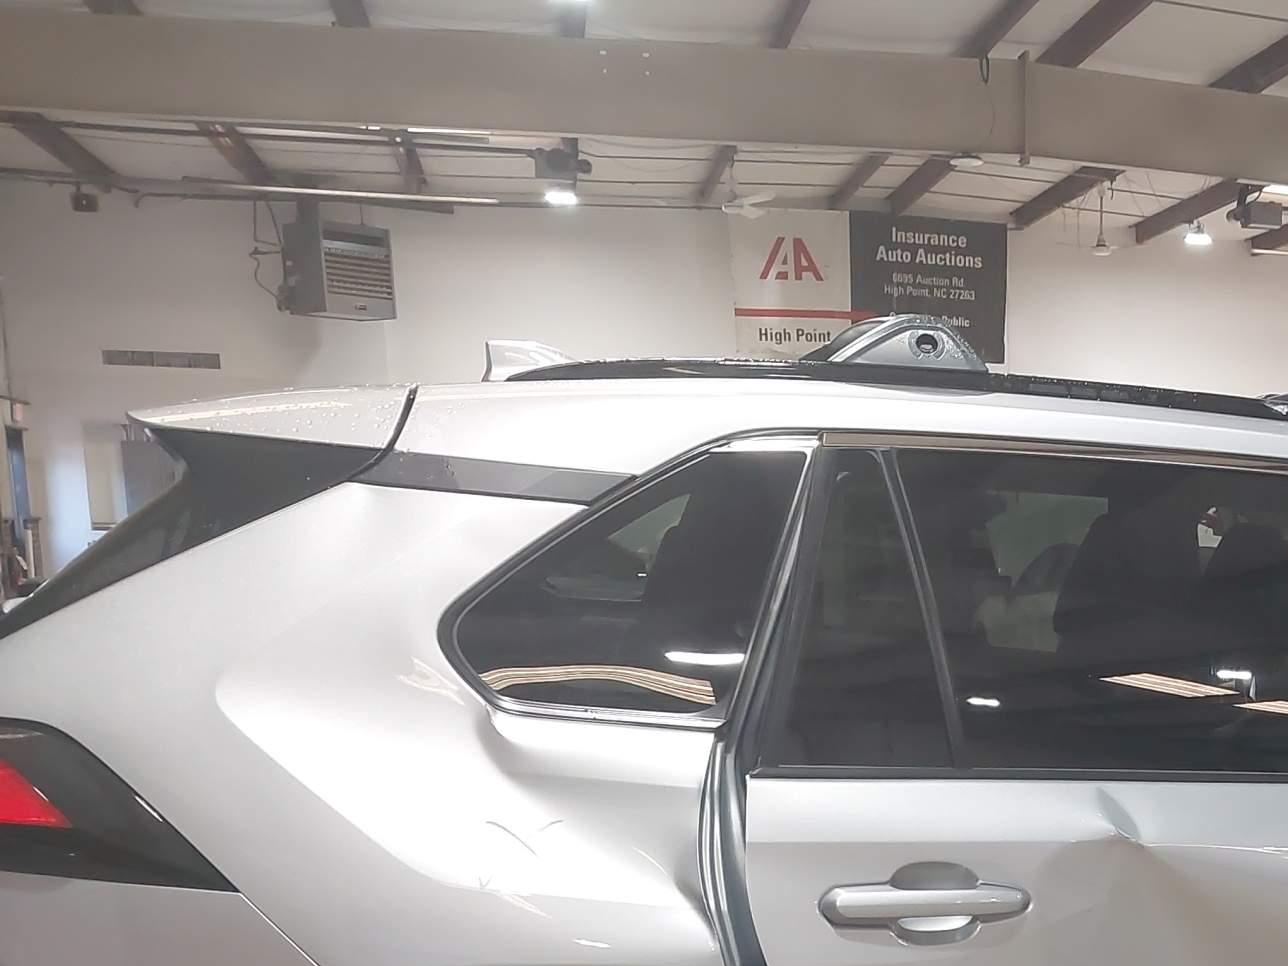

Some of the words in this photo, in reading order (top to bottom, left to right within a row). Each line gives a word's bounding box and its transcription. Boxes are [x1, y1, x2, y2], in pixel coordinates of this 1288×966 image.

[892, 226, 967, 248] Insurance
[876, 245, 911, 263] Auto
[915, 248, 982, 269] Auctions
[916, 274, 950, 287] Auction
[884, 284, 904, 297] High
[933, 287, 947, 299] NC
[759, 327, 792, 345] High
[796, 328, 831, 343] Point
